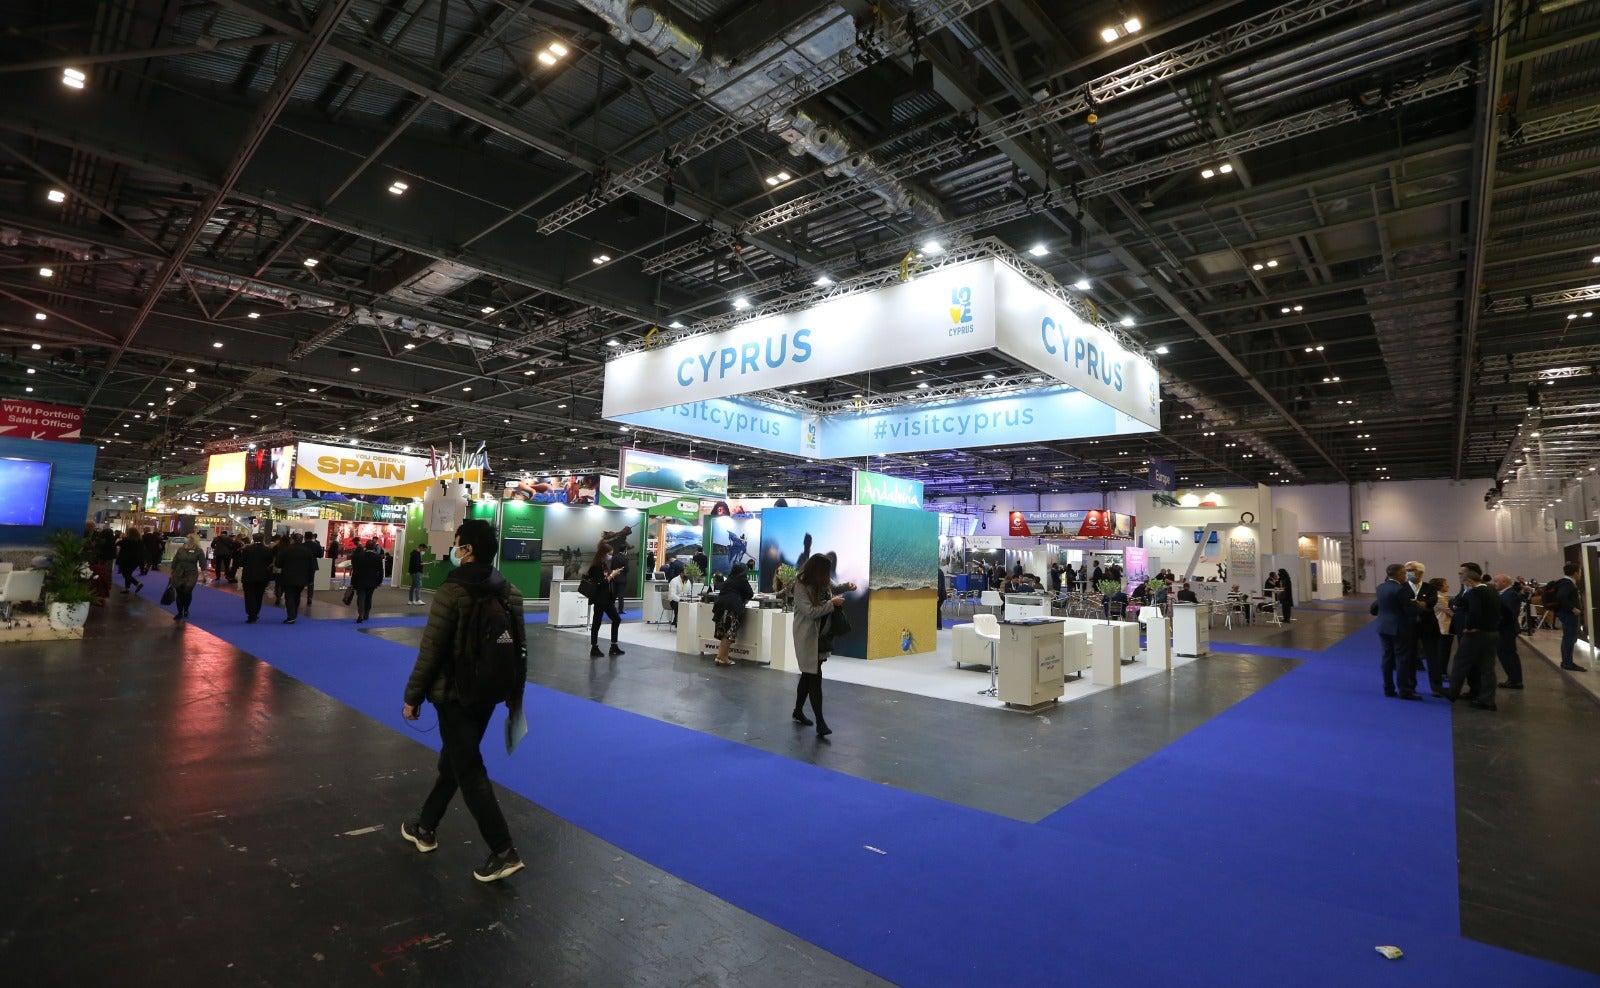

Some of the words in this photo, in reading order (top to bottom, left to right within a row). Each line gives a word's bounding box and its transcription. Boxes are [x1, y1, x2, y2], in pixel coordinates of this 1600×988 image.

[949, 324, 974, 336] CYPRUS
[677, 329, 811, 386] CYPRUS
[1041, 317, 1123, 392] CYPRUS
[3, 404, 32, 415] WTM
[35, 408, 80, 421] Portfolio
[8, 415, 38, 425] Sales
[41, 419, 73, 429] Office
[873, 407, 1034, 439] #visitcyprus
[317, 455, 405, 481] SPAIN
[372, 456, 406, 464] DESERVE
[1155, 469, 1171, 486] Europe
[214, 492, 271, 506] Balears
[610, 484, 658, 503] SPAIN
